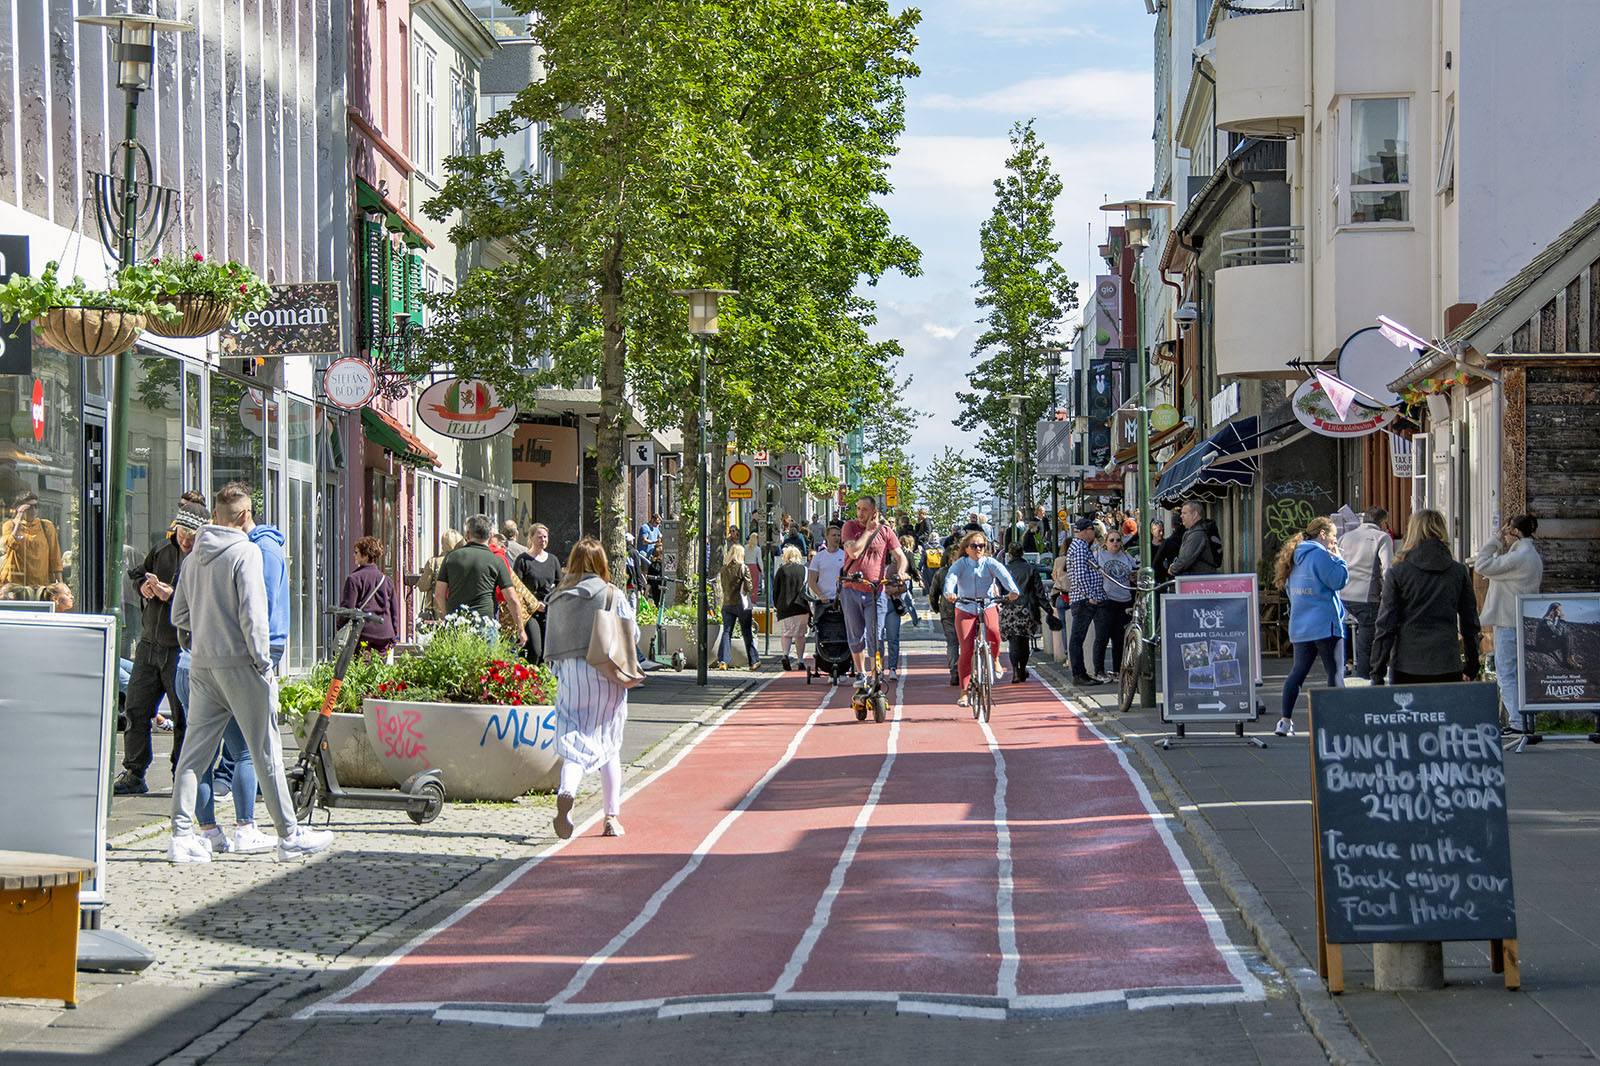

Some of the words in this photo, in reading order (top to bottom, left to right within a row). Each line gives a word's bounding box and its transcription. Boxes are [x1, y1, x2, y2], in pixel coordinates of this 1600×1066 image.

[1395, 456, 1407, 464] TAX
[788, 466, 801, 477] 66
[1193, 608, 1224, 620] Magic
[1200, 617, 1224, 628] ICE
[1545, 684, 1585, 699] ÁLAFOSS
[1318, 728, 1410, 761] LUNCH
[1434, 785, 1503, 810] SODA
[1323, 829, 1402, 860] Terrace
[1410, 842, 1434, 862] in
[1437, 838, 1481, 864] the
[1333, 863, 1400, 889] Back
[1405, 868, 1460, 900] enjoy
[1466, 873, 1509, 892] our
[1338, 891, 1398, 922] Food
